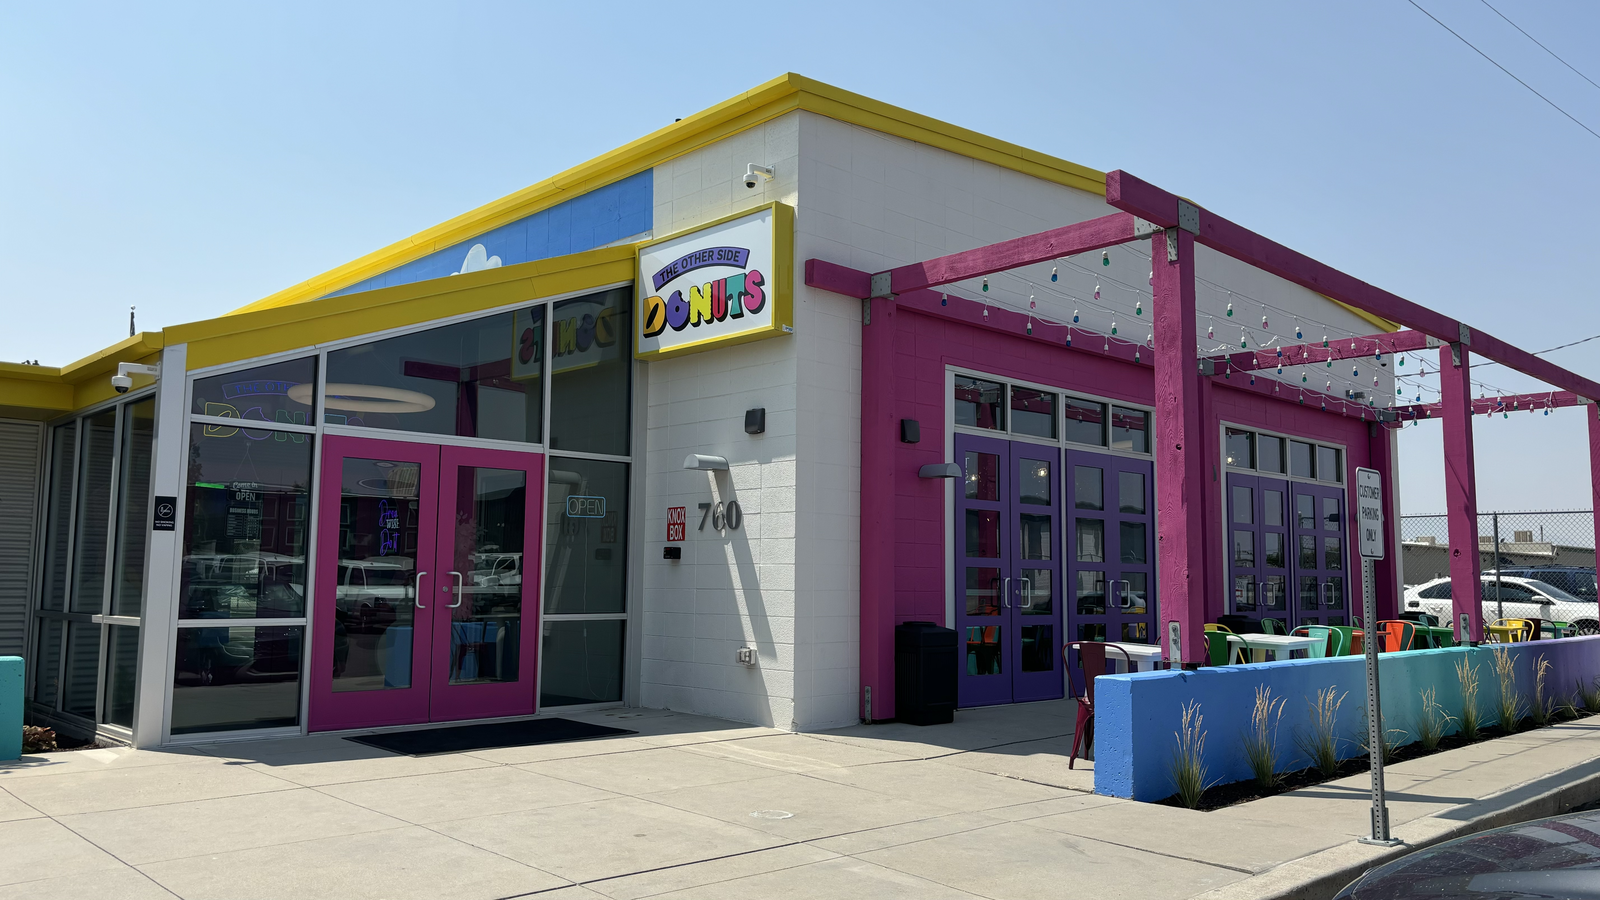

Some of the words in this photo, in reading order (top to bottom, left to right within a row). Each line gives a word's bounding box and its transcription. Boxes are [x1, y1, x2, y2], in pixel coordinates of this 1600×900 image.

[660, 264, 680, 282] THE
[681, 250, 715, 270] OTHER
[717, 249, 741, 262] SIDE
[643, 270, 766, 339] DONUTS
[234, 382, 260, 395] THE
[264, 381, 293, 393] OTH
[236, 492, 256, 501] OPEN
[1360, 485, 1379, 499] CUSTOMER
[568, 498, 605, 516] OPEN
[1362, 506, 1379, 521] PARKING
[667, 508, 686, 524] KNOX
[698, 500, 742, 531] 760
[669, 525, 684, 541] BOX
[1366, 528, 1376, 542] ONLY
